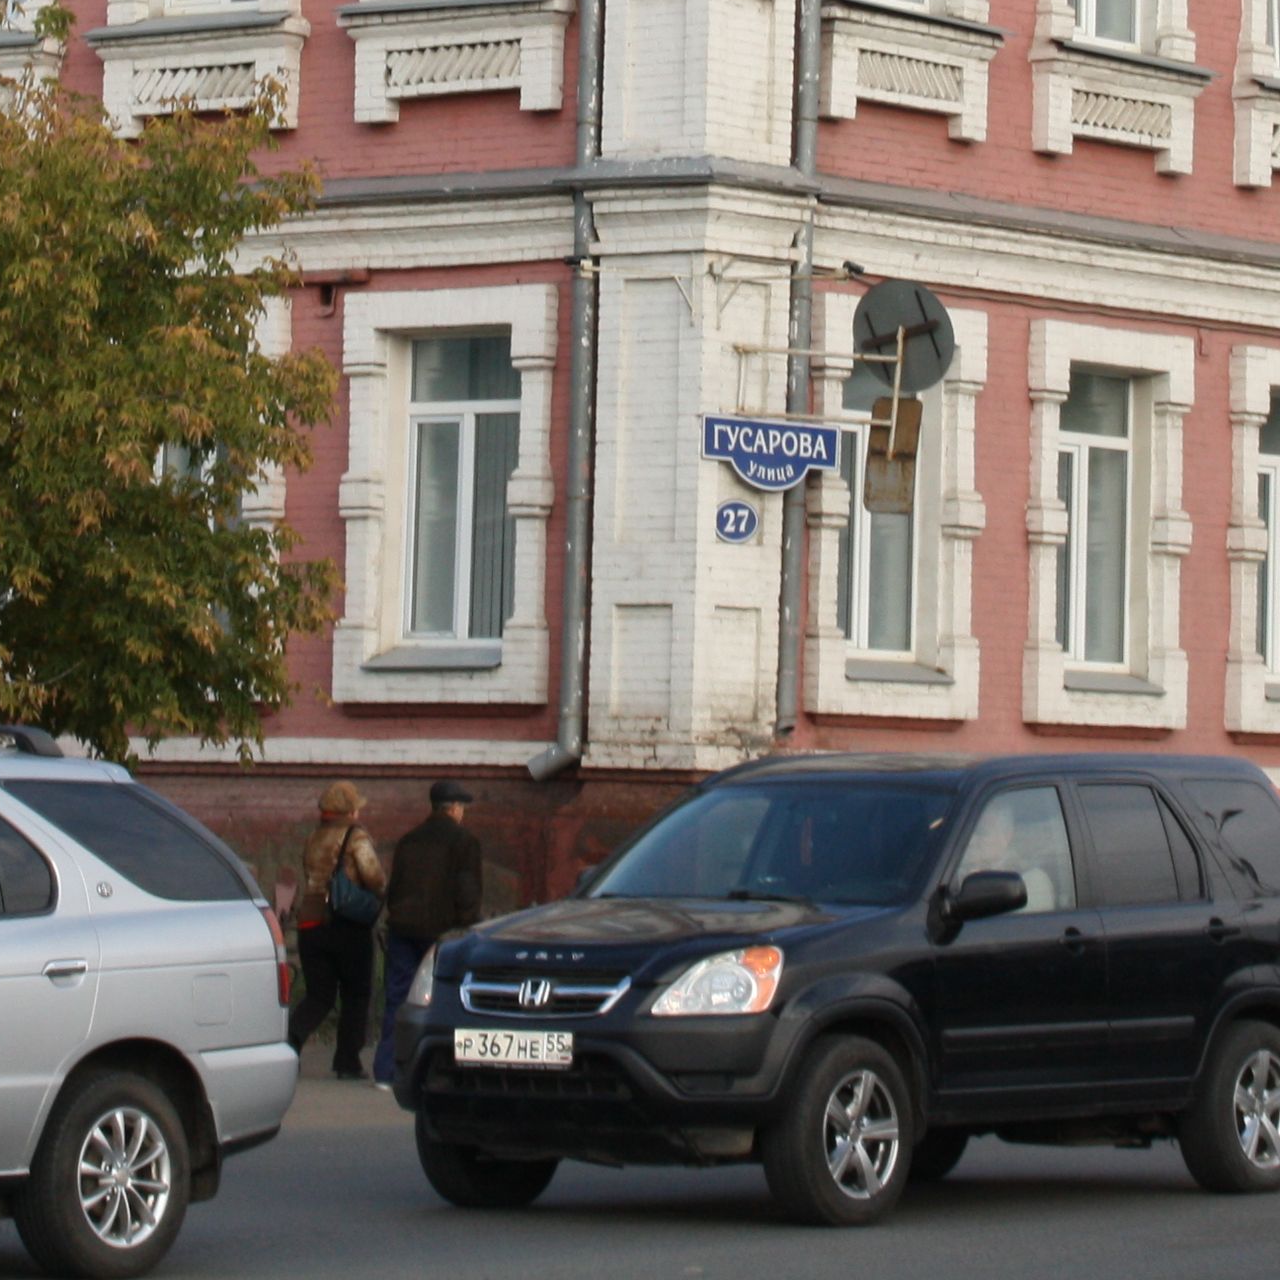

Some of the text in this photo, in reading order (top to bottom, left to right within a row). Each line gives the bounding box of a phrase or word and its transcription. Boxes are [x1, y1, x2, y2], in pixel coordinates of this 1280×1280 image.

[713, 423, 828, 461] ГУСАРОВА
[746, 460, 794, 482] улица
[722, 508, 750, 533] 27
[546, 1034, 566, 1053] 55
